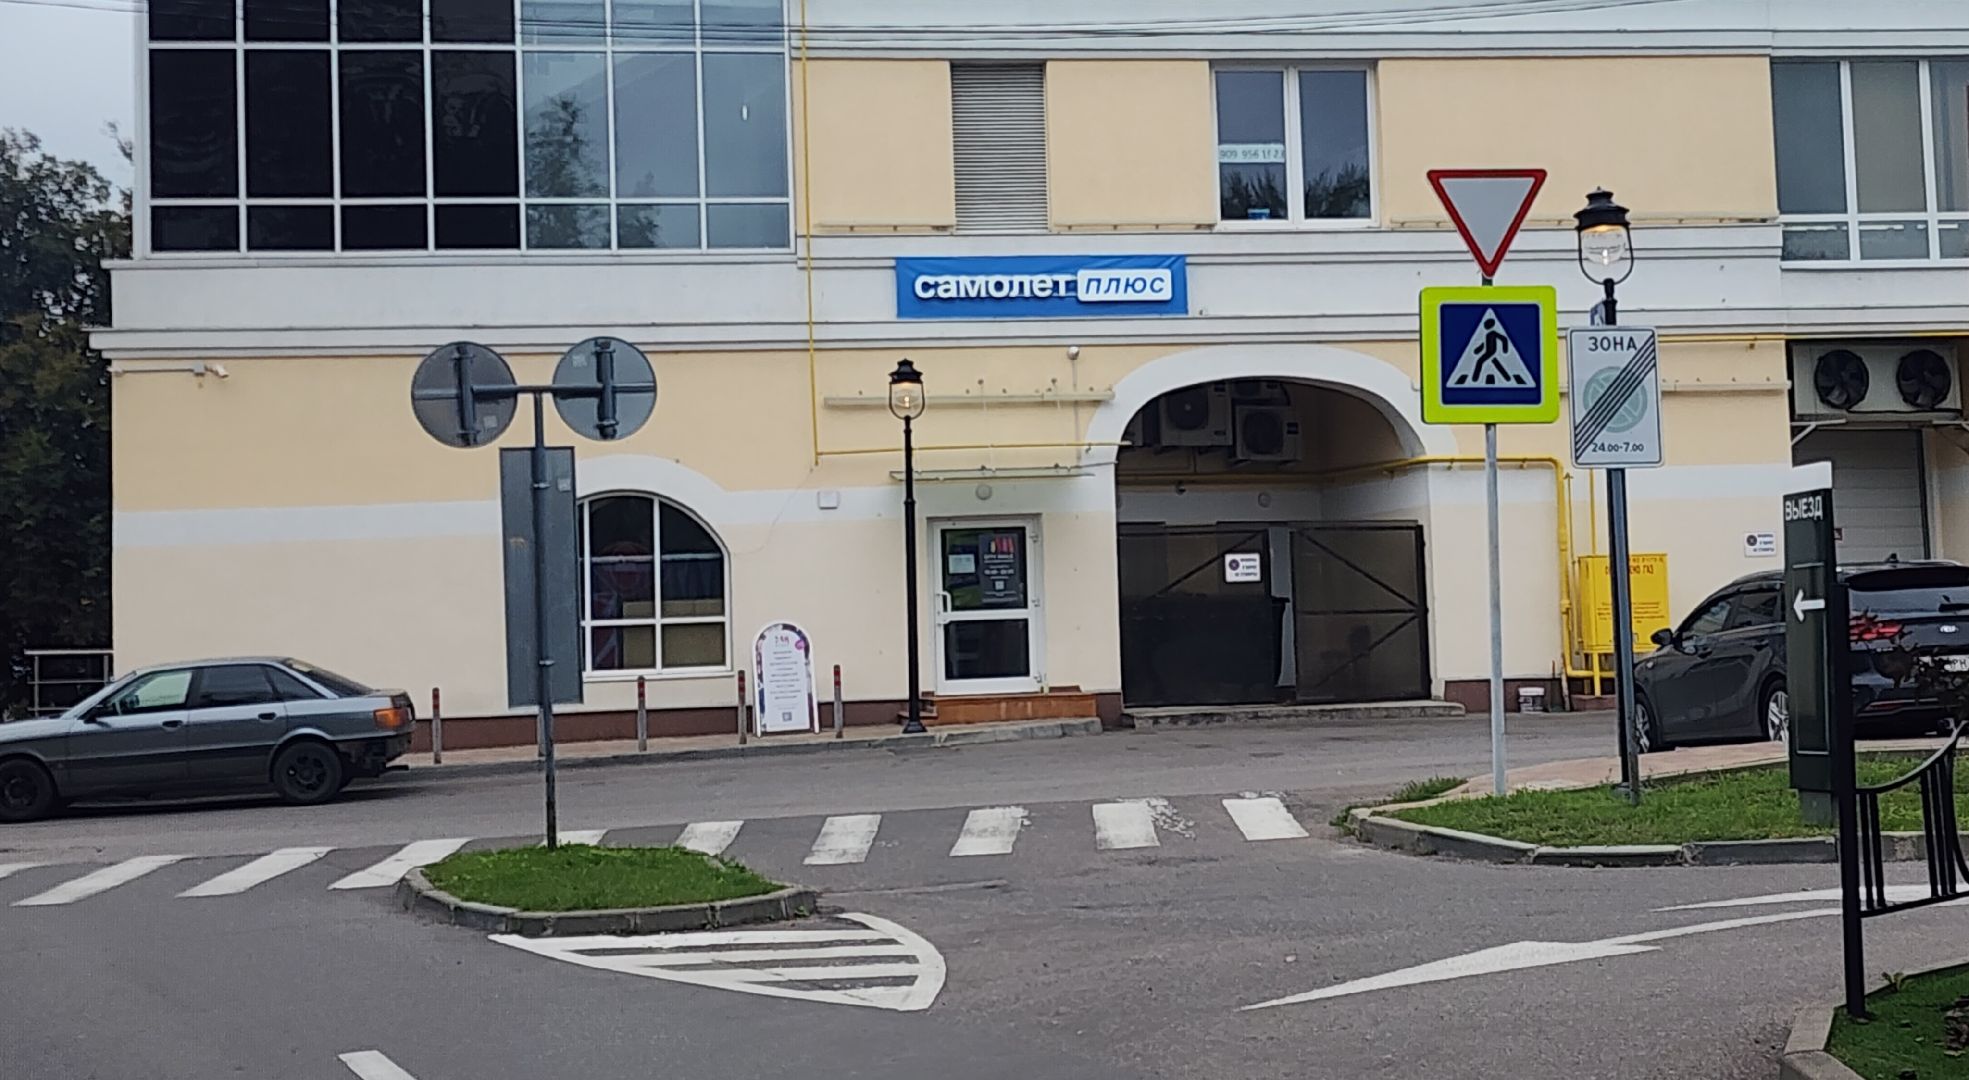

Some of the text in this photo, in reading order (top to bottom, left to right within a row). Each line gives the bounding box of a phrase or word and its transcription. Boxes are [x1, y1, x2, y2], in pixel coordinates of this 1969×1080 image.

[914, 274, 1077, 298] самолет
[1588, 336, 1637, 352] ЗОНА
[1591, 442, 1645, 453] 24.00-7.00
[1785, 496, 1823, 521] ВЫЕЗД
